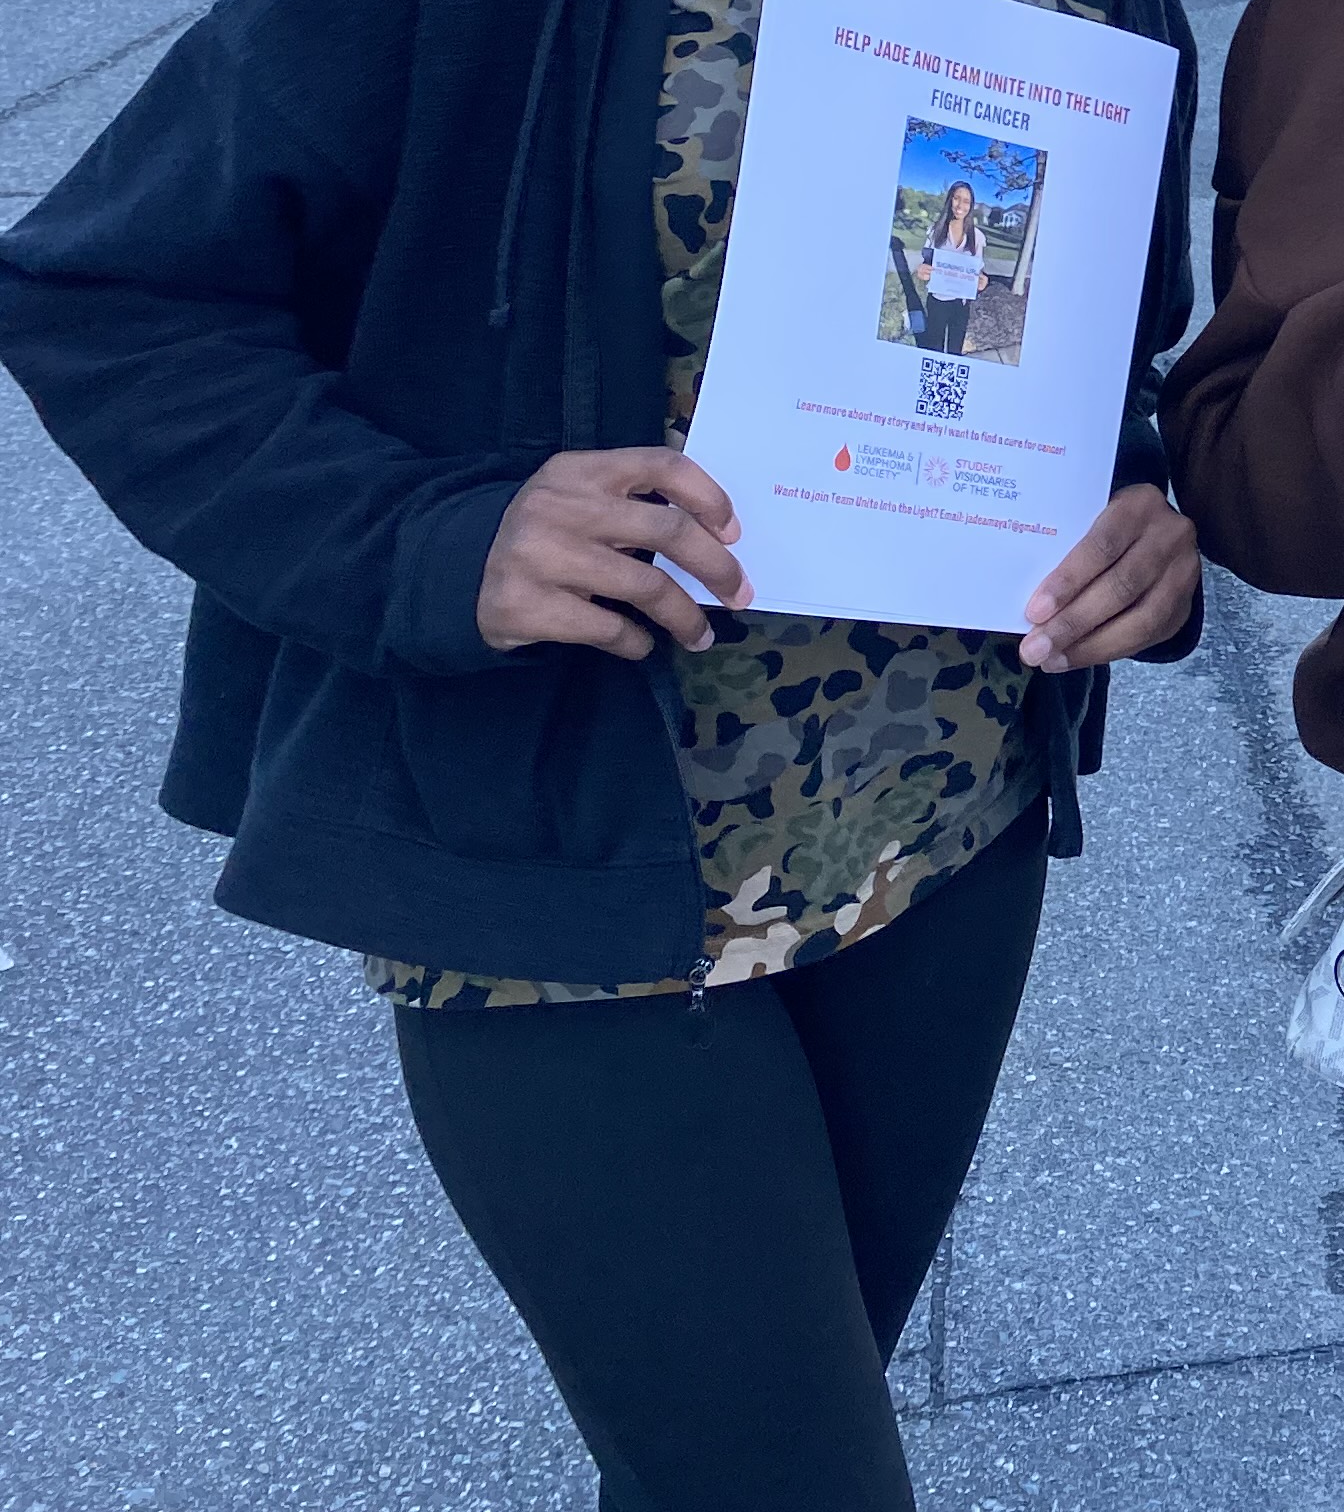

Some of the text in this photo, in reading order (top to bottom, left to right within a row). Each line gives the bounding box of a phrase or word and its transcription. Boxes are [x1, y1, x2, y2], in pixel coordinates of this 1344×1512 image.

[834, 26, 1131, 125] HELP JADE AND TEAM UNITE INTO THE LIGHT
[930, 88, 1031, 131] FIGHT CANCER
[857, 444, 905, 460] LEUKEMIA
[855, 454, 912, 472] LYMPHOMA
[955, 458, 1003, 475] STUDENT
[854, 465, 898, 480] SOCIETY
[954, 470, 1017, 489] VISIONARIES
[952, 482, 968, 493] OF
[969, 484, 990, 497] THE
